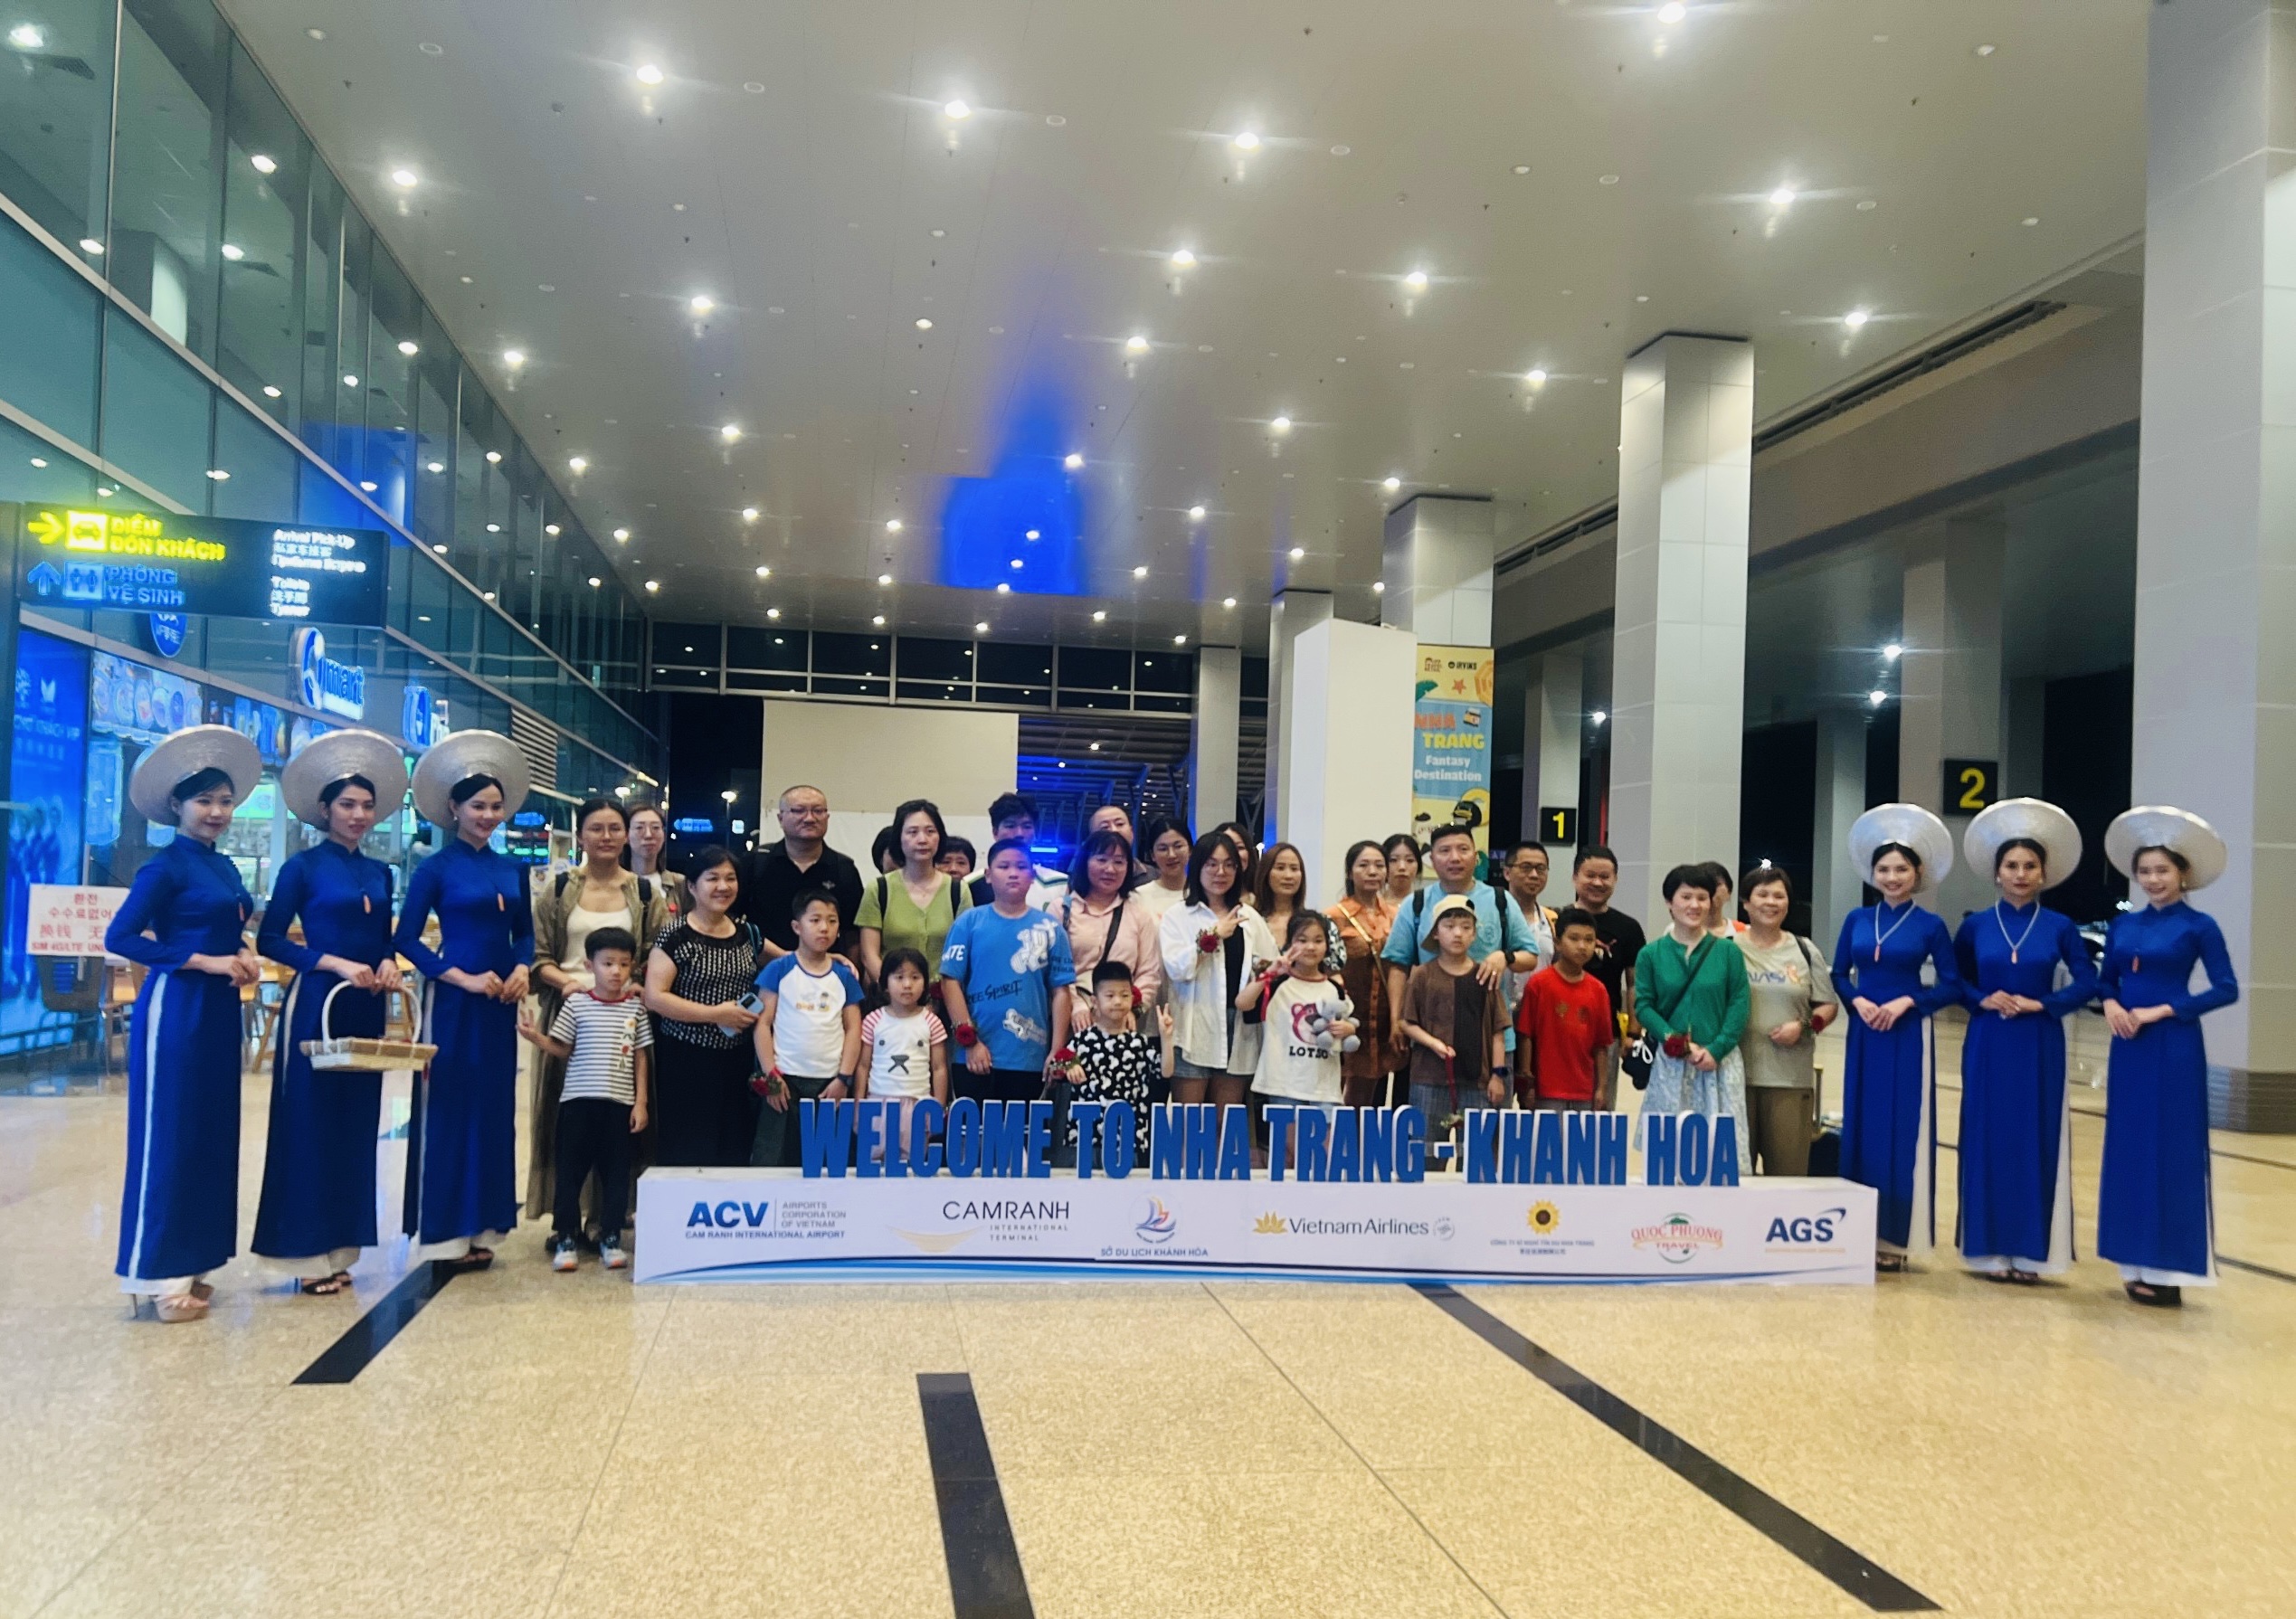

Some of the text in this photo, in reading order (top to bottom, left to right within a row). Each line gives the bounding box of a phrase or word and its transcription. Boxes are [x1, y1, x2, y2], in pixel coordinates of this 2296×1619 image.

[156, 537, 226, 561] KHÁCH
[138, 587, 185, 606] SINH
[1414, 713, 1456, 731] NHA
[1422, 732, 1485, 750] TRANG
[1425, 754, 1471, 768] Fantasy
[1414, 769, 1483, 782] Destination
[1959, 768, 1986, 809] 2
[1551, 811, 1565, 839] 1
[800, 1096, 1053, 1179] WELCOME
[1071, 1099, 1137, 1179] TO
[1150, 1102, 1251, 1180] NHA
[1263, 1103, 1426, 1183] TRANG
[1464, 1108, 1628, 1186] KHANH
[1642, 1110, 1741, 1187] HOA
[687, 1200, 769, 1228] ACV
[782, 1201, 827, 1210] AIRPORTS
[782, 1210, 847, 1218] CORPORATION
[943, 1200, 1069, 1220] CAMRANH
[782, 1220, 836, 1228] OF VIETNAM
[1290, 1217, 1362, 1235] Vietnam
[1364, 1217, 1429, 1236] Airlines
[1766, 1217, 1834, 1242] AGS
[735, 1231, 804, 1239] INTERNATIONAL
[806, 1231, 845, 1239] AIRPORT
[990, 1234, 1039, 1242] TERMINAL
[1115, 1248, 1128, 1256] DU
[1153, 1246, 1186, 1257] KHÁNH
